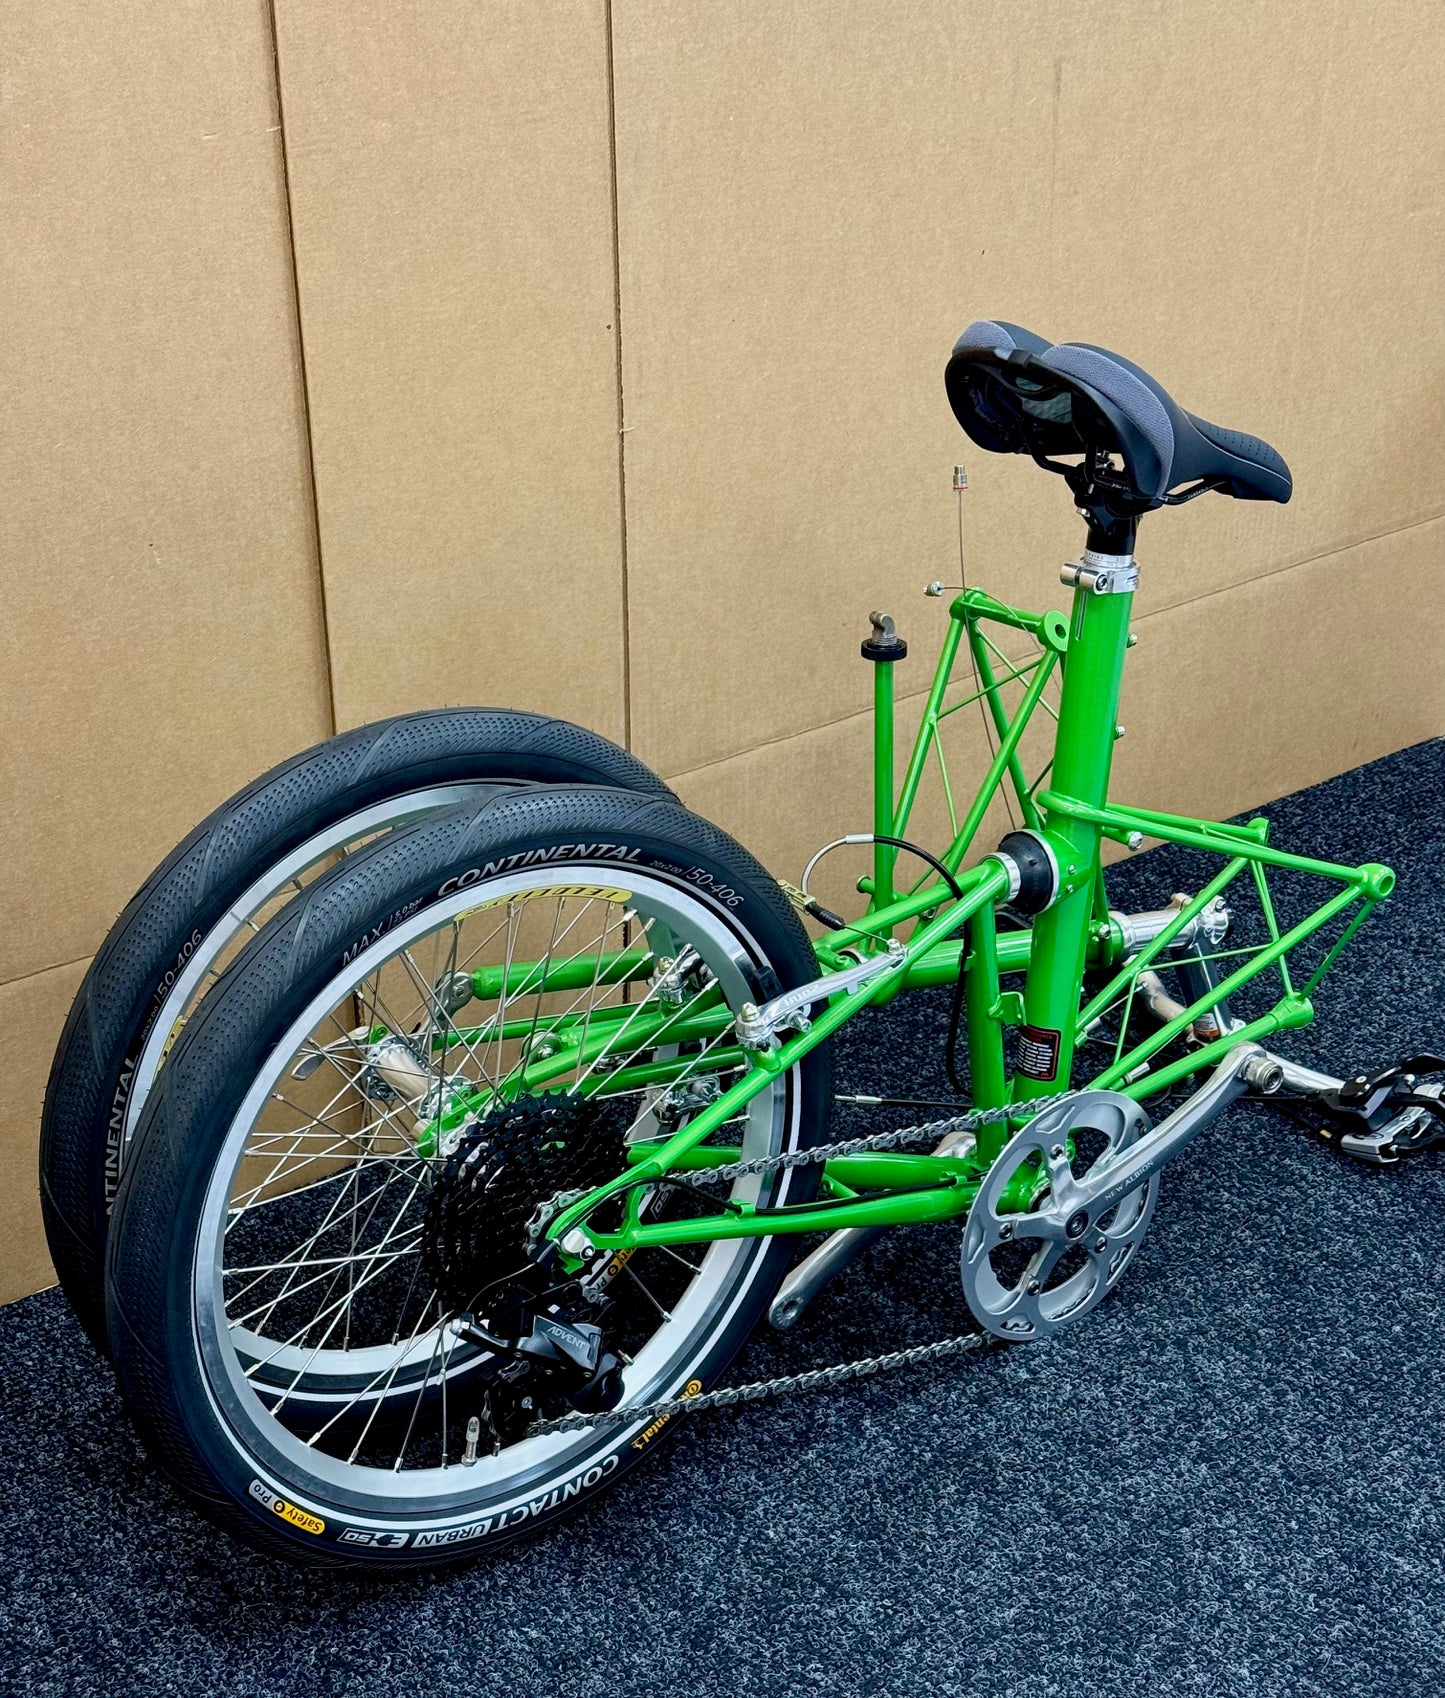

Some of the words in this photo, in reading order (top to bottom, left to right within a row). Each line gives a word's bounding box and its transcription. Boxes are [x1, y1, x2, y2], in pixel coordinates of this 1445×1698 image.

[438, 844, 641, 897] CONTINENTAL
[1105, 1184, 1124, 1201] NEW
[1125, 1160, 1154, 1187] ALBION
[547, 1326, 586, 1350] ADVENT
[254, 1484, 273, 1504] Pro
[491, 1454, 619, 1533] CONTACT
[286, 1507, 323, 1532] Safety
[417, 1521, 489, 1547] URBAN
